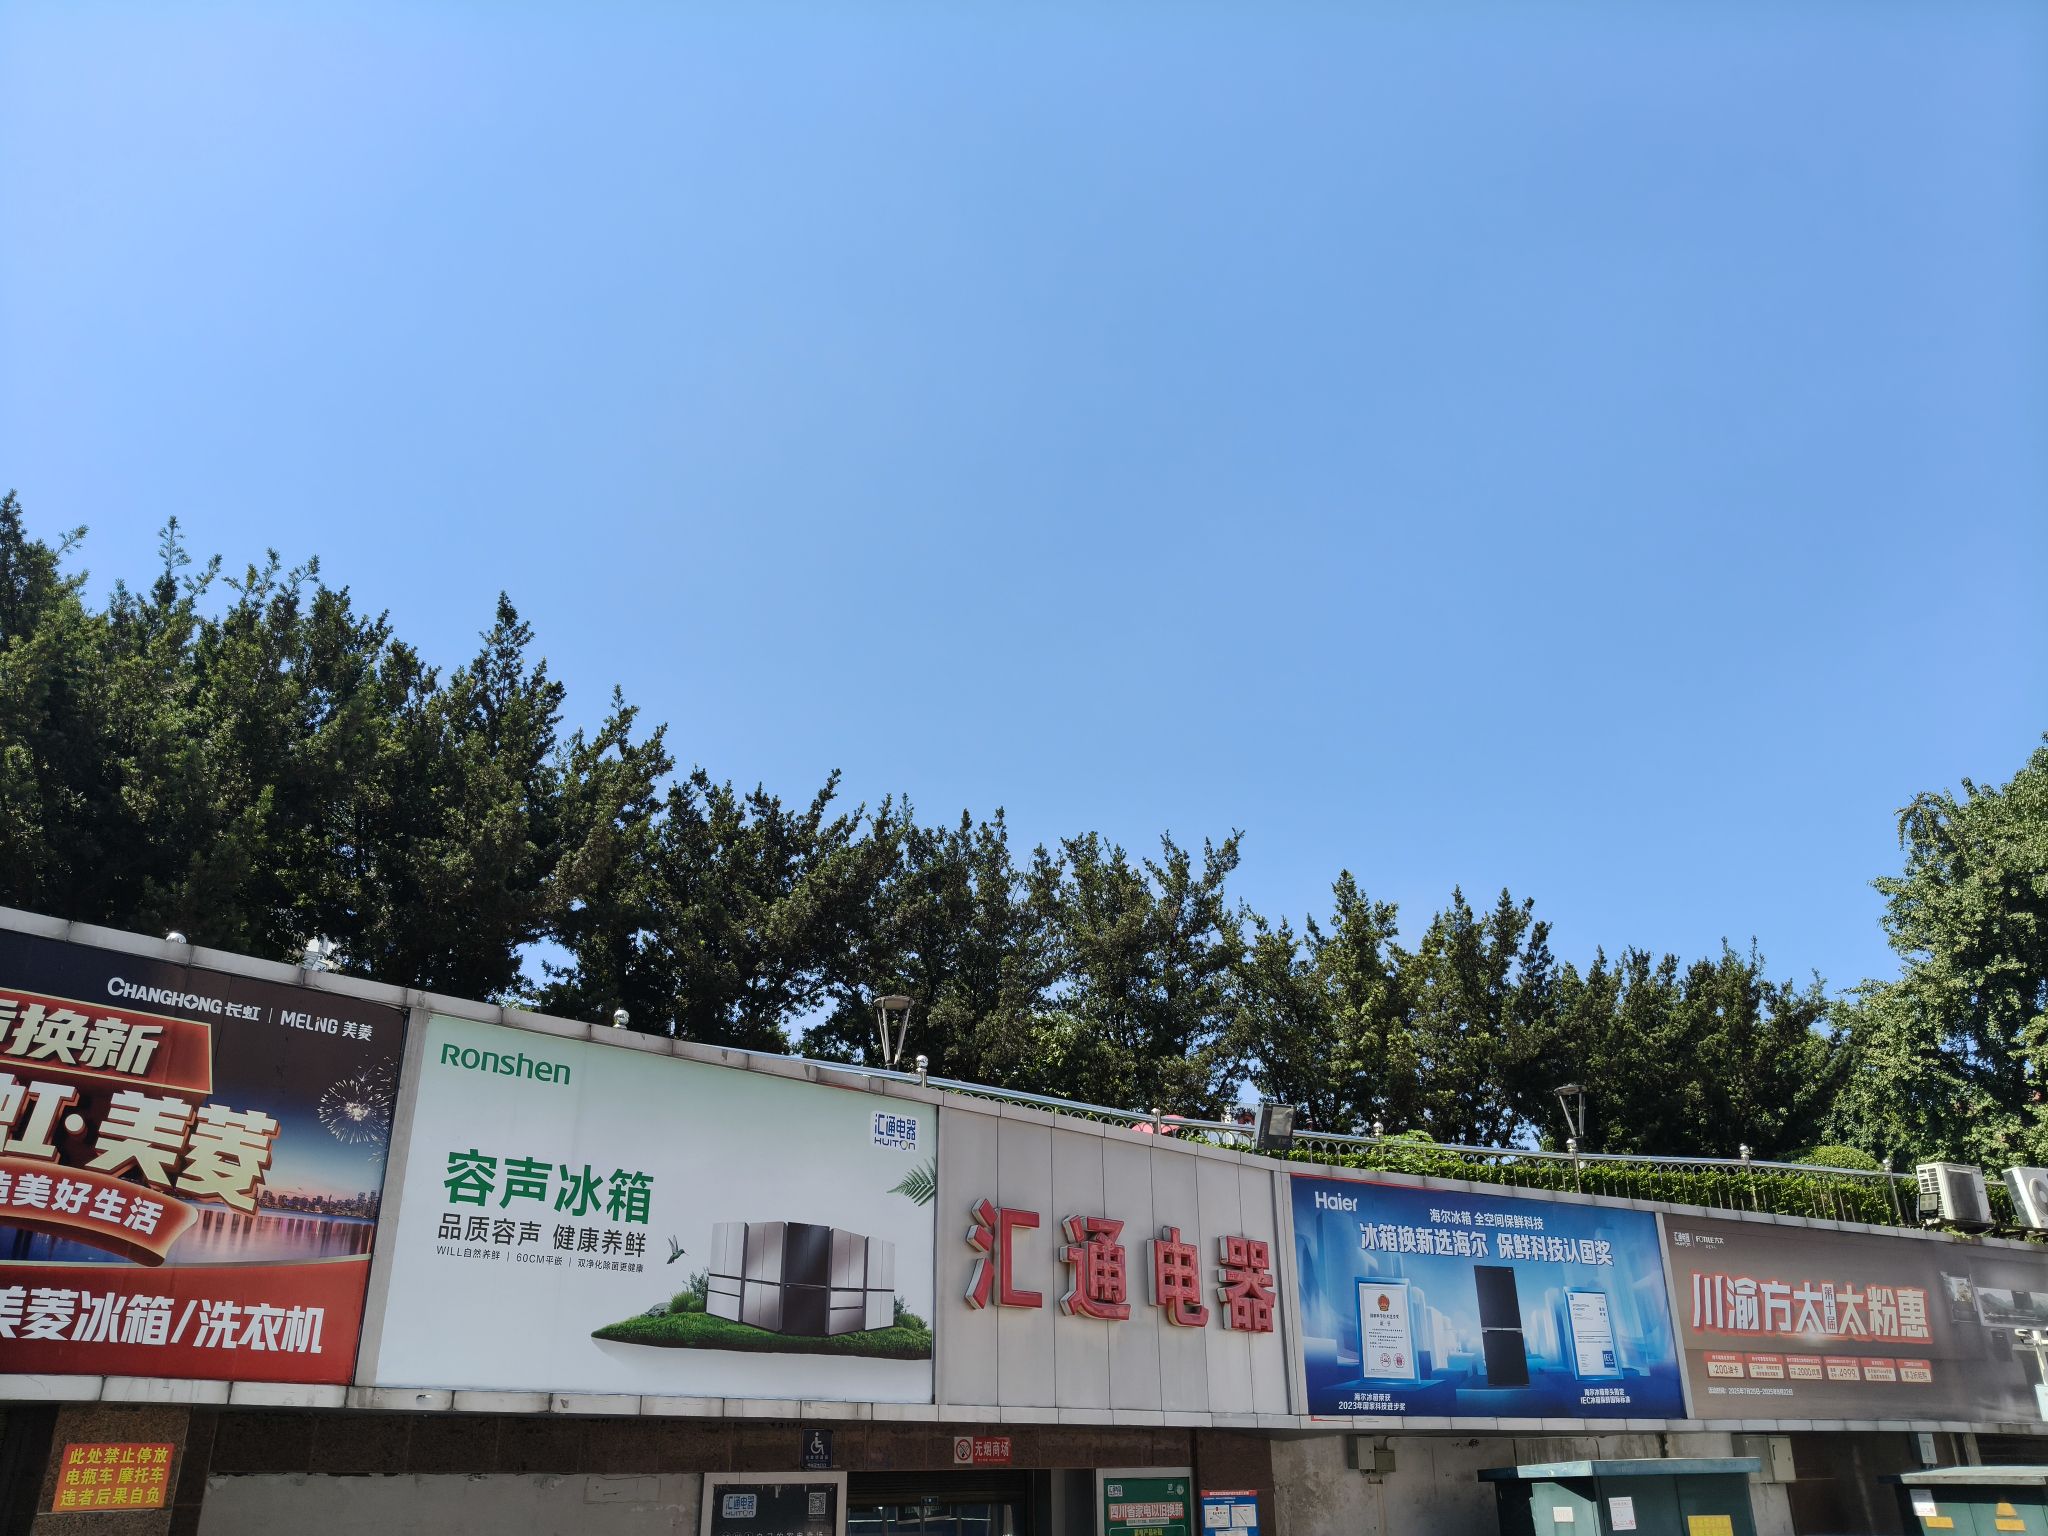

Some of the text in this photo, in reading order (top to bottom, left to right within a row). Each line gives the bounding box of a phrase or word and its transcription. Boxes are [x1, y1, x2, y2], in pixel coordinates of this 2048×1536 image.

[107, 977, 222, 1014] CHANGHONG
[225, 1003, 262, 1021] 长虹
[341, 1021, 374, 1042] 美菱
[440, 1043, 571, 1085] Ronshen
[874, 1113, 916, 1140] 汇通电器
[443, 1148, 655, 1225] 容声冰箱
[1314, 1191, 1358, 1212] Haier
[1429, 1208, 1545, 1231] 海尔冰箱 全空间保鲜科技
[437, 1212, 647, 1258] 品质容声 健康养鲜
[1359, 1222, 1614, 1266] 冰箱换新选海尔 保鲜科技认国奖
[965, 1198, 1277, 1333] 汇通电器
[1338, 1401, 1406, 1411] 2023年国家科技进步奖
[68, 1447, 169, 1465] 此处禁止停放
[975, 1440, 1009, 1457] 无烟商场
[65, 1466, 165, 1485] 电瓶车 摩托车
[60, 1486, 160, 1507] 违者后果自负
[1110, 1502, 1183, 1519] 四川省家电以旧换新
